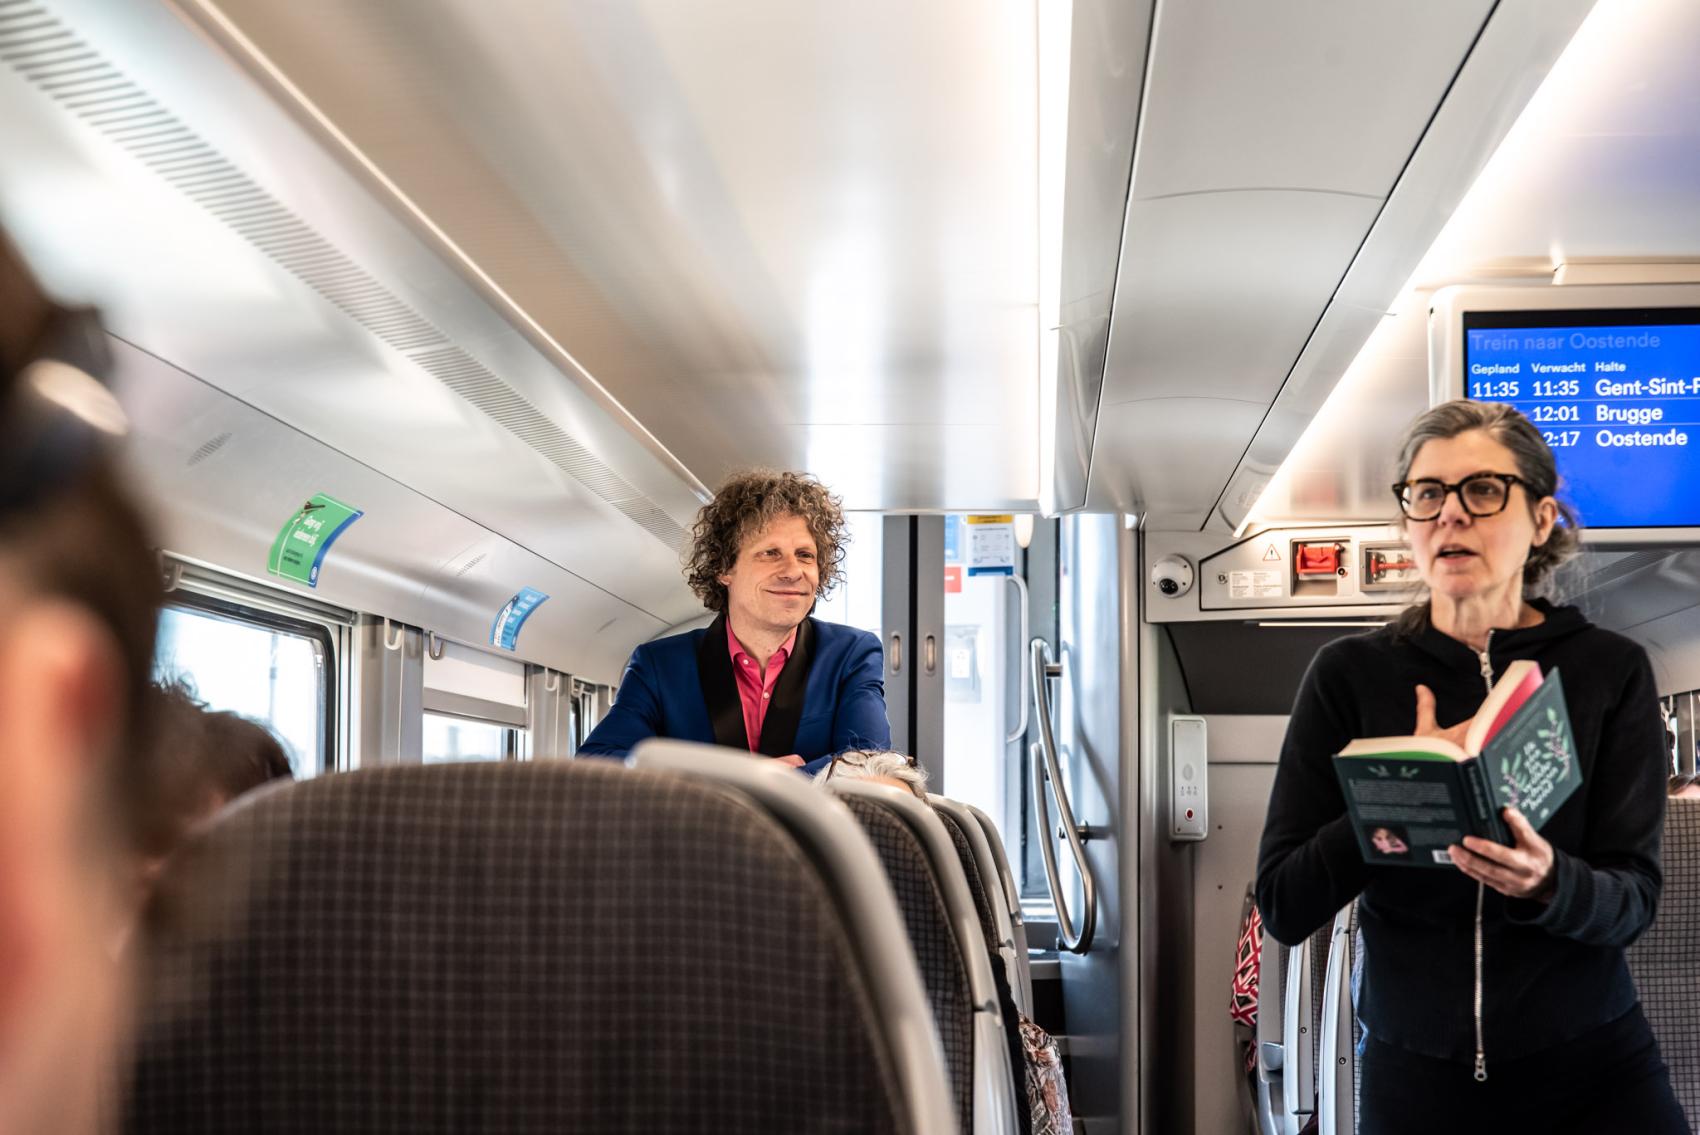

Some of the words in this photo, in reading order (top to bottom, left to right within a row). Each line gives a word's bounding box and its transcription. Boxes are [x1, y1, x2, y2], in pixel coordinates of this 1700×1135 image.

[1472, 334, 1520, 351] Trein
[1524, 337, 1565, 350] naar
[1570, 332, 1661, 350] Oostende
[1471, 363, 1520, 376] Gepland
[1531, 362, 1586, 373] Verwacht
[1595, 361, 1627, 372] Halte
[1473, 381, 1519, 398] 11:35
[1533, 380, 1580, 397] 11:35
[1533, 405, 1580, 422] 12:01
[1596, 404, 1663, 425] Brugge
[1543, 431, 1581, 447] 2:17
[1596, 428, 1688, 447] Oostende
